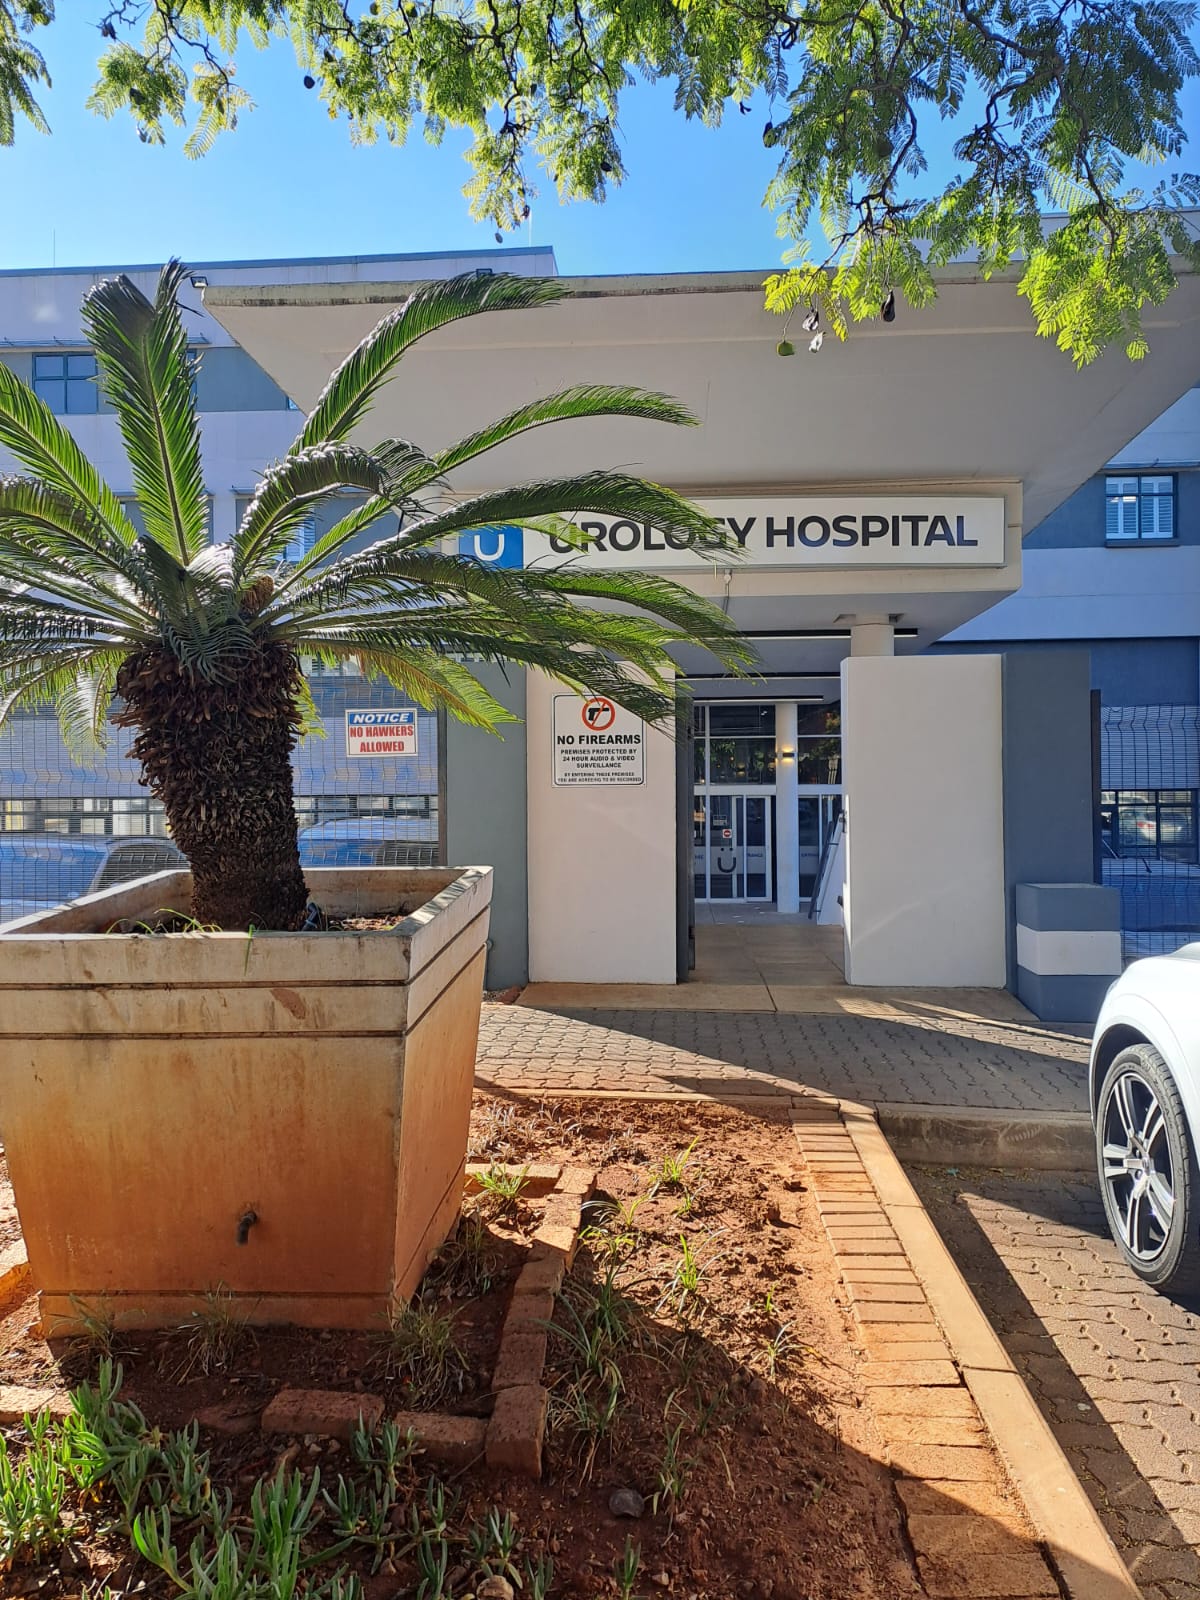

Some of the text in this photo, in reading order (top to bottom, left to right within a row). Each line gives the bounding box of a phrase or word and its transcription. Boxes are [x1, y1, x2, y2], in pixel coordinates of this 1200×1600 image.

[766, 513, 978, 548] HOSPITAL
[353, 713, 410, 724] NOTICE
[349, 726, 414, 738] NO HAWKERS
[557, 735, 641, 745] NO FIREARMS
[360, 741, 404, 753] ALLOWED
